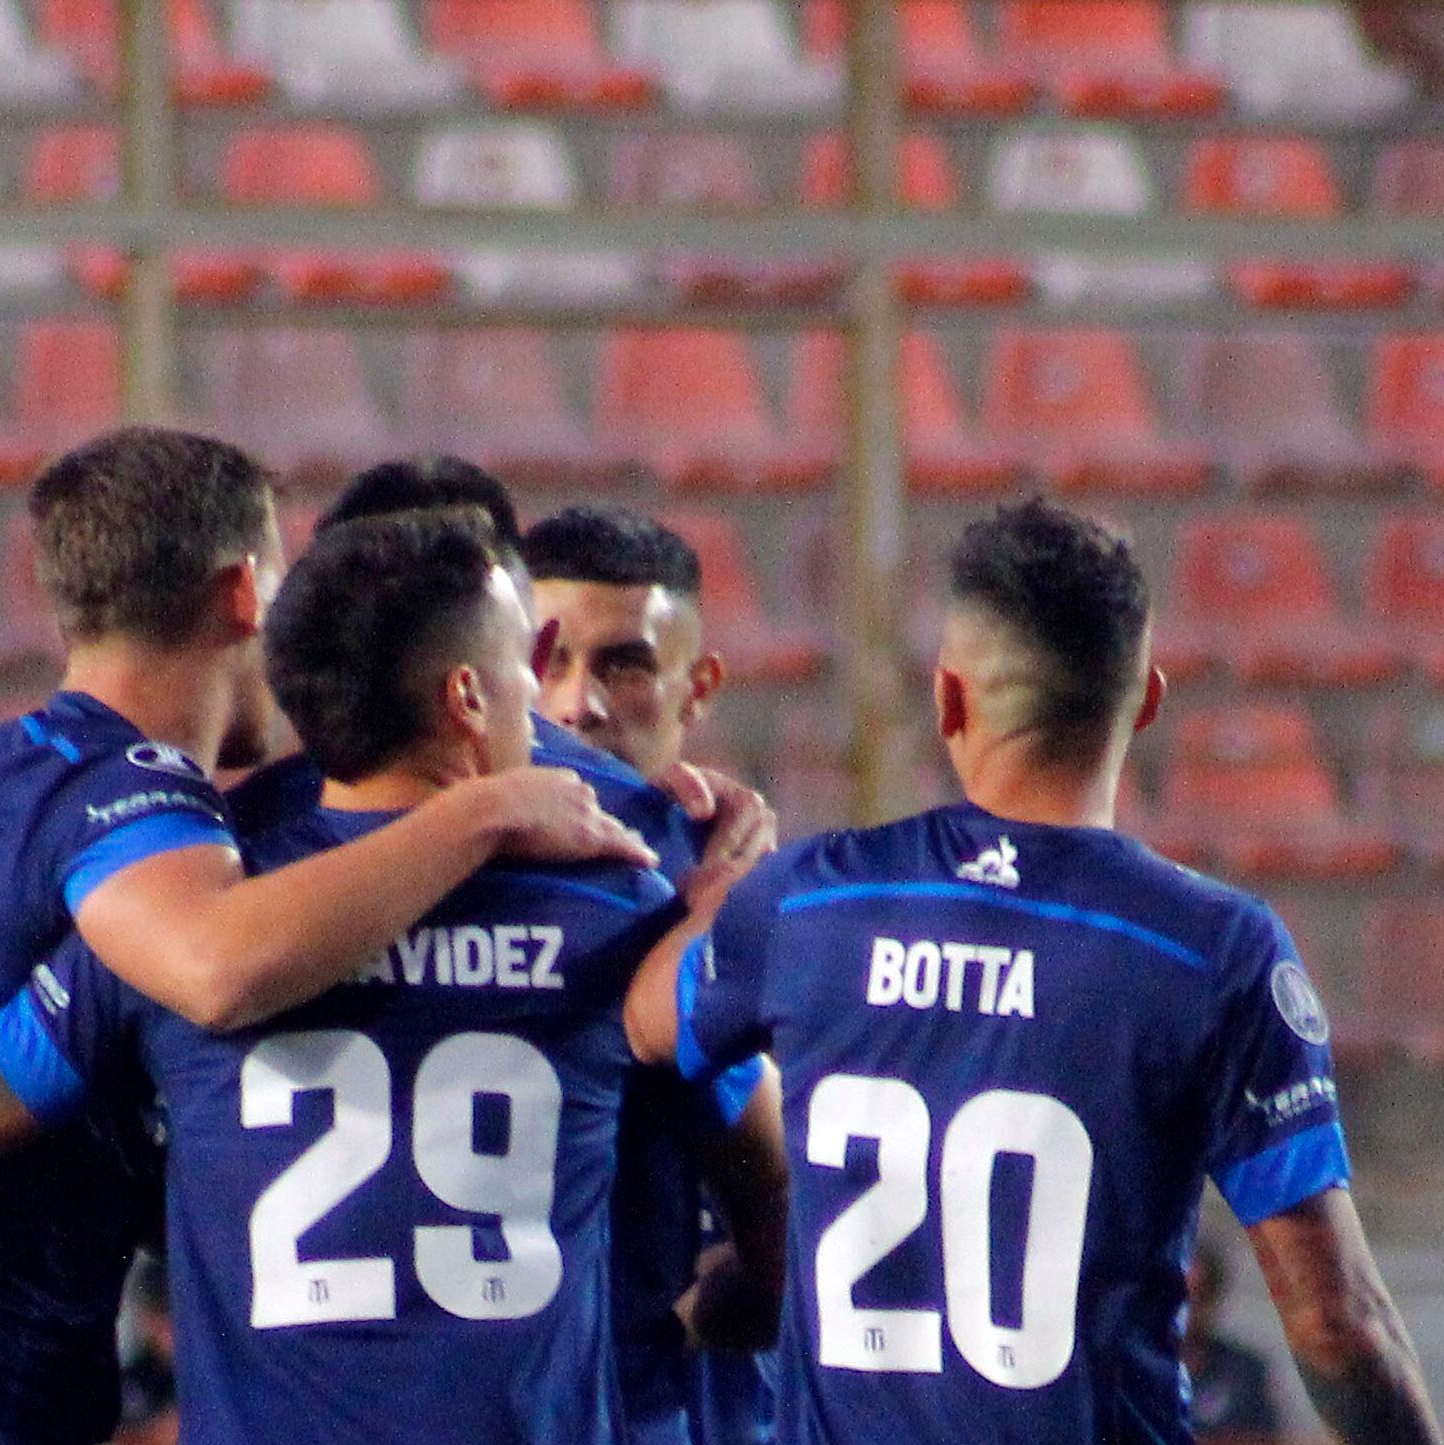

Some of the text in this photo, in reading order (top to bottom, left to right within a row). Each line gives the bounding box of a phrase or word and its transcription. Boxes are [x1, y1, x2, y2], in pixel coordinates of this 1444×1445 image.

[866, 936, 1035, 1018] BOTTA
[240, 1029, 564, 1329] 29
[805, 1073, 1094, 1389] 20
